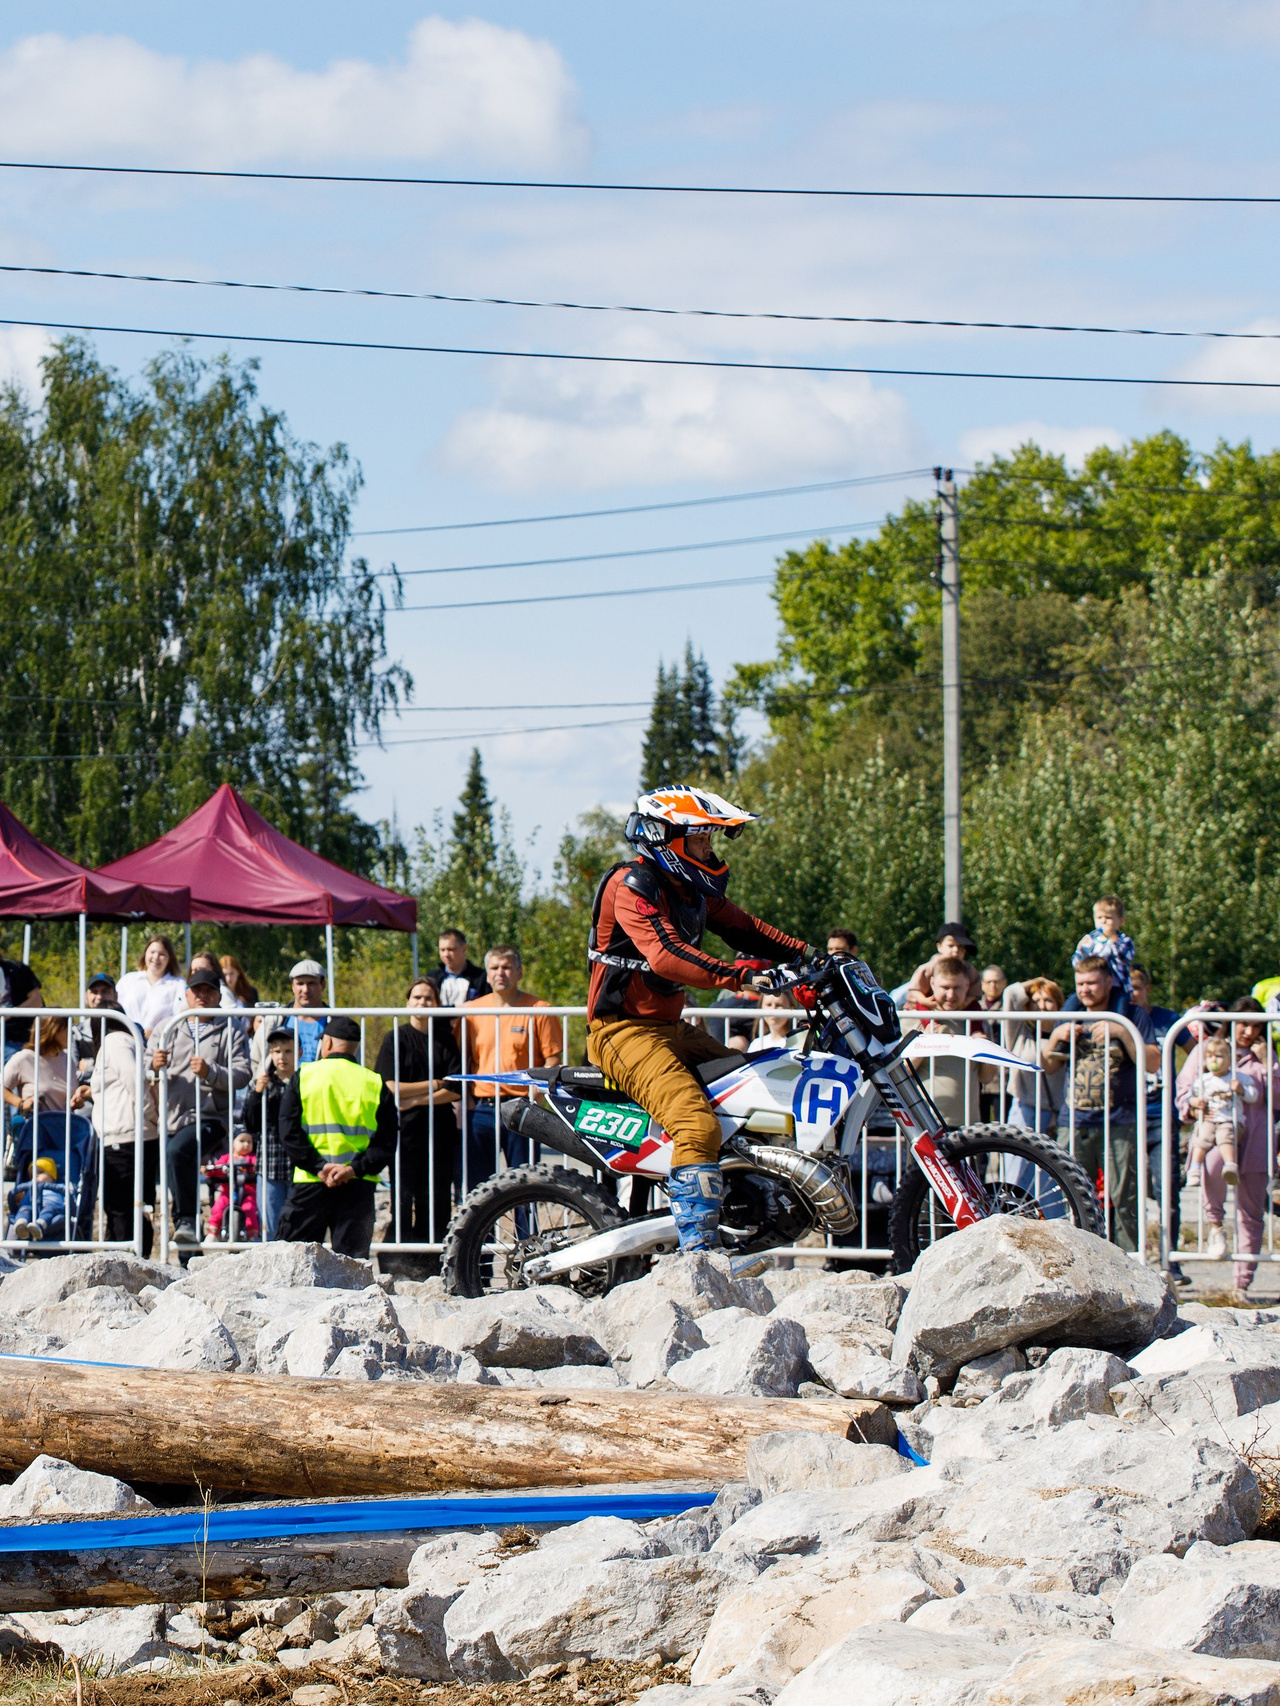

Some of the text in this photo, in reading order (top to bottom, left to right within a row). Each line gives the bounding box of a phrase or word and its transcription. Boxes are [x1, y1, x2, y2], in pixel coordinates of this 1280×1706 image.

[573, 1071, 603, 1079] Husqvarna
[578, 1107, 643, 1142] 230
[929, 1164, 955, 1200] MOTOREX
